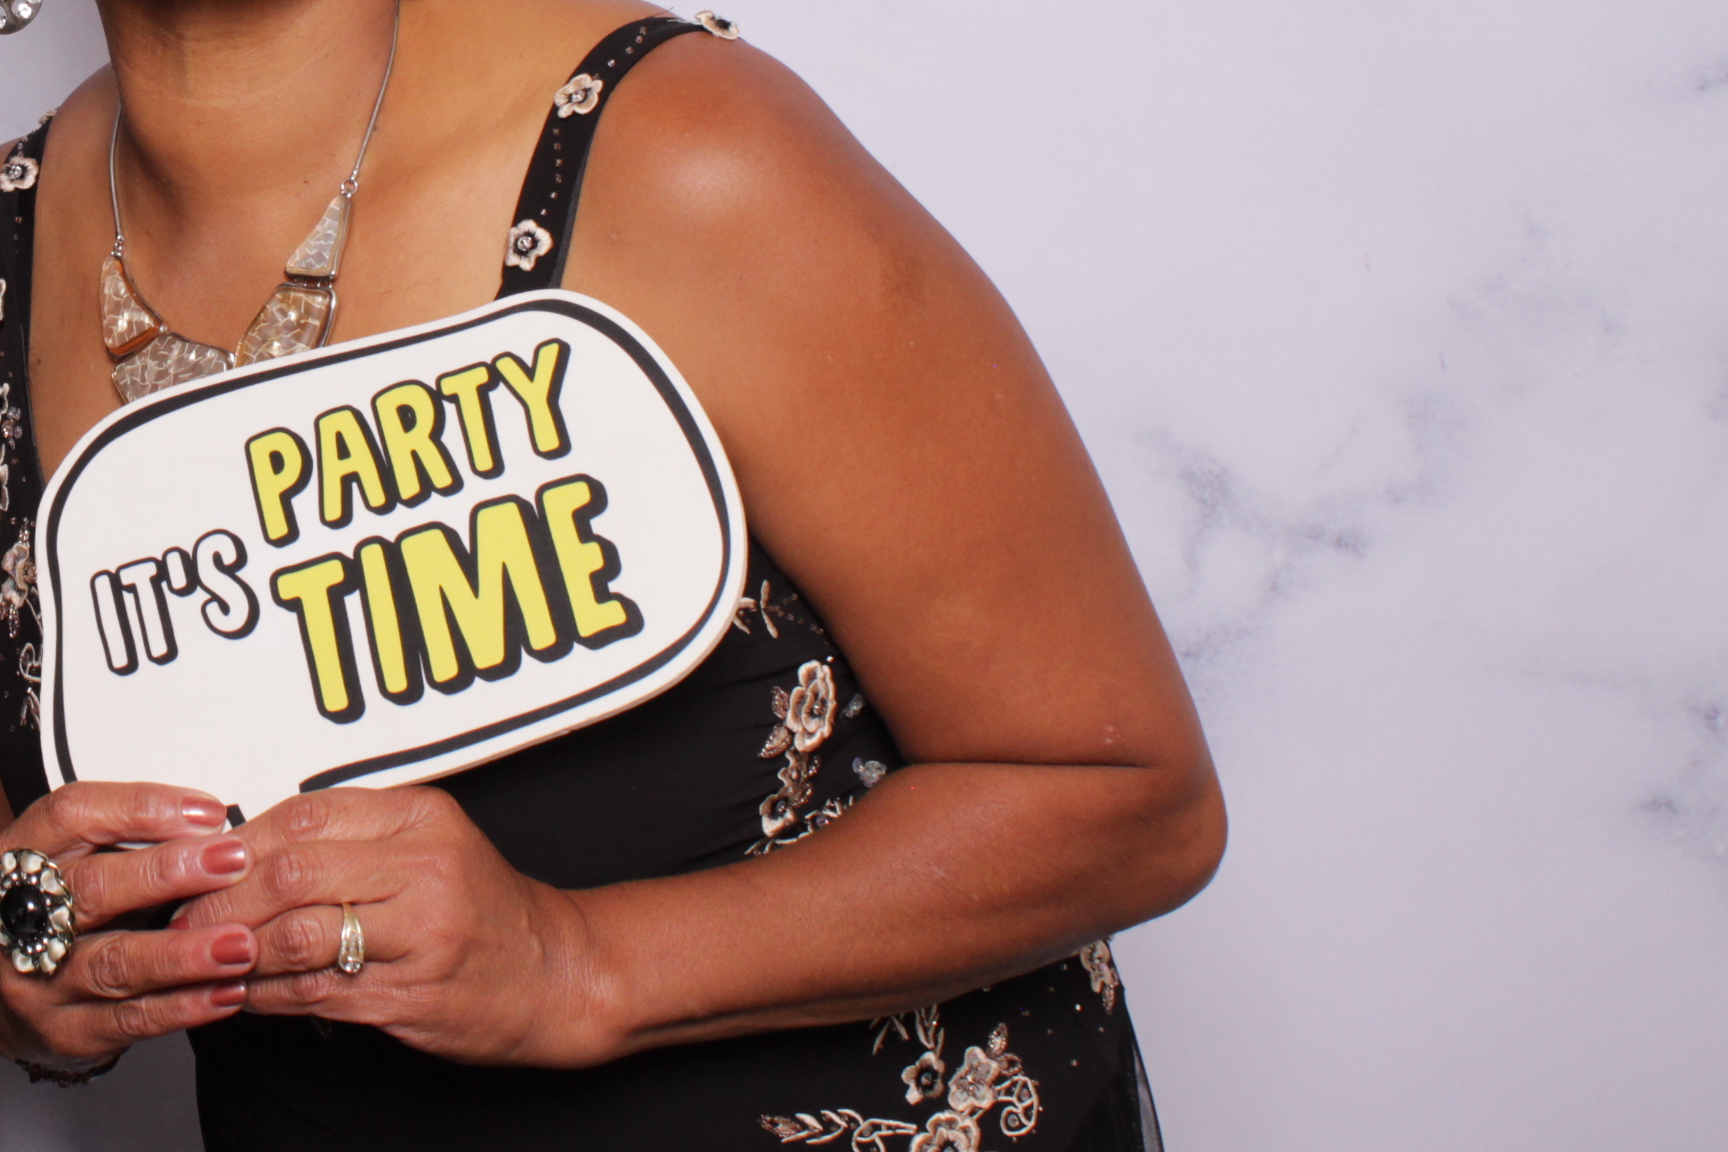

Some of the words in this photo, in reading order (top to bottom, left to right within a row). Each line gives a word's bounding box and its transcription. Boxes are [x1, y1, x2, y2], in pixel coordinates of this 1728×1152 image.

[245, 339, 570, 547] PARTY
[91, 529, 260, 676] IT'S
[270, 474, 645, 724] TIME
